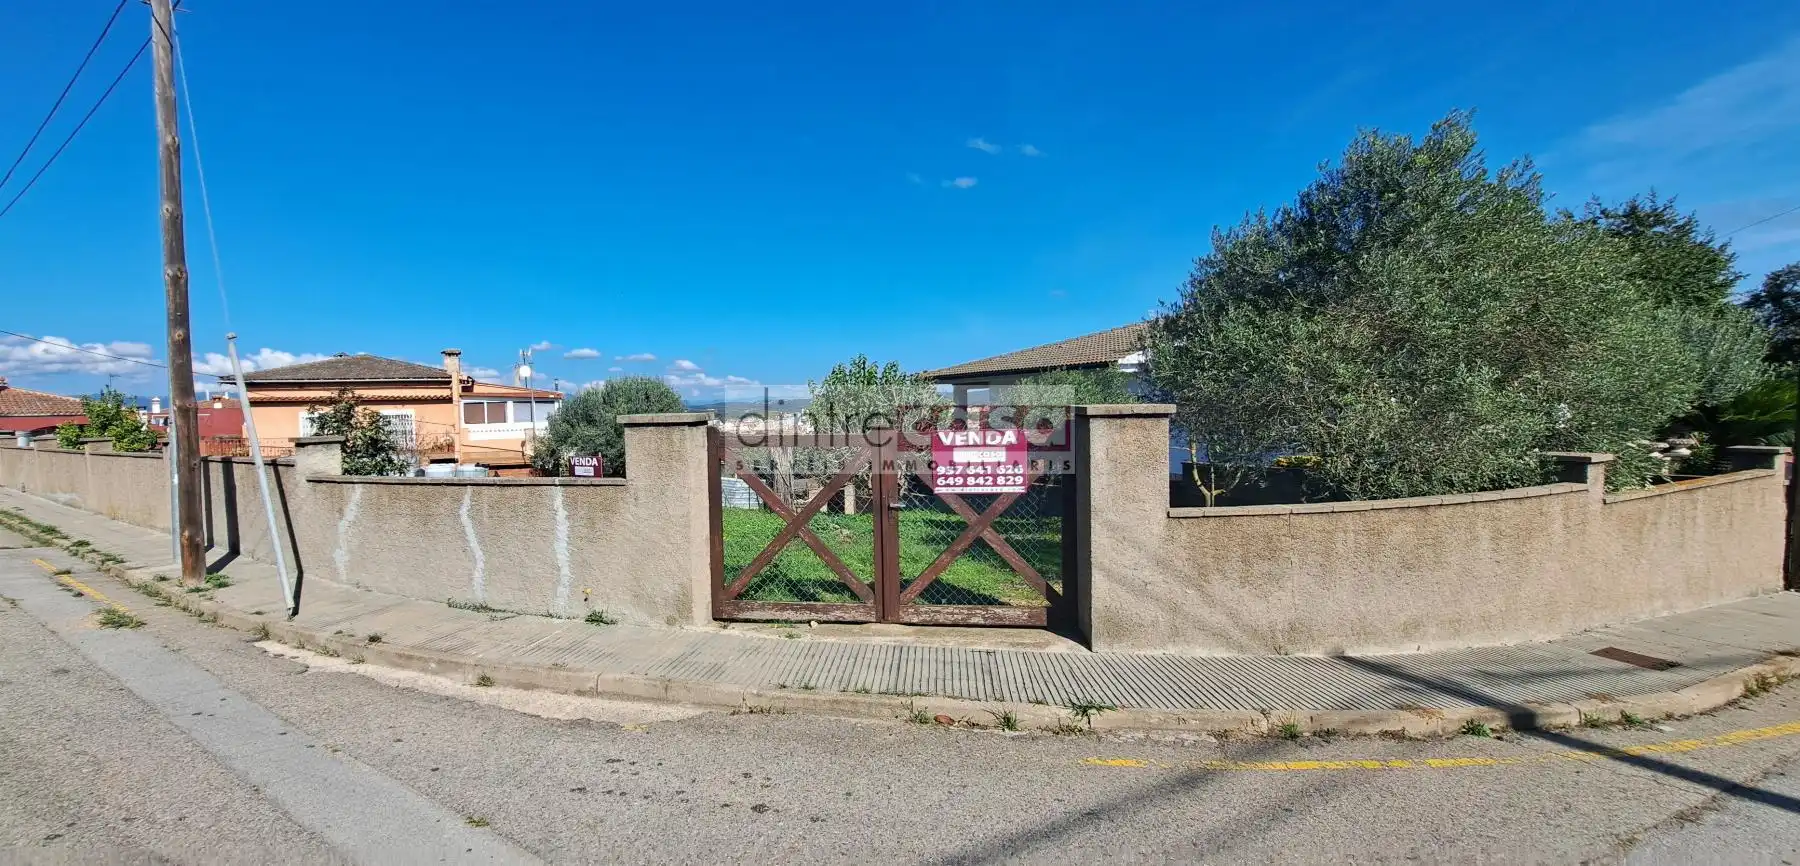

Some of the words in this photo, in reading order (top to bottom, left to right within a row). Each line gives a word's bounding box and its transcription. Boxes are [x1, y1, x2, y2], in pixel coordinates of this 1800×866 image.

[937, 430, 1018, 446] VENDA
[570, 457, 598, 466] VENDA
[936, 476, 964, 486] 649
[966, 476, 993, 486] 842
[996, 475, 1024, 485] 829
